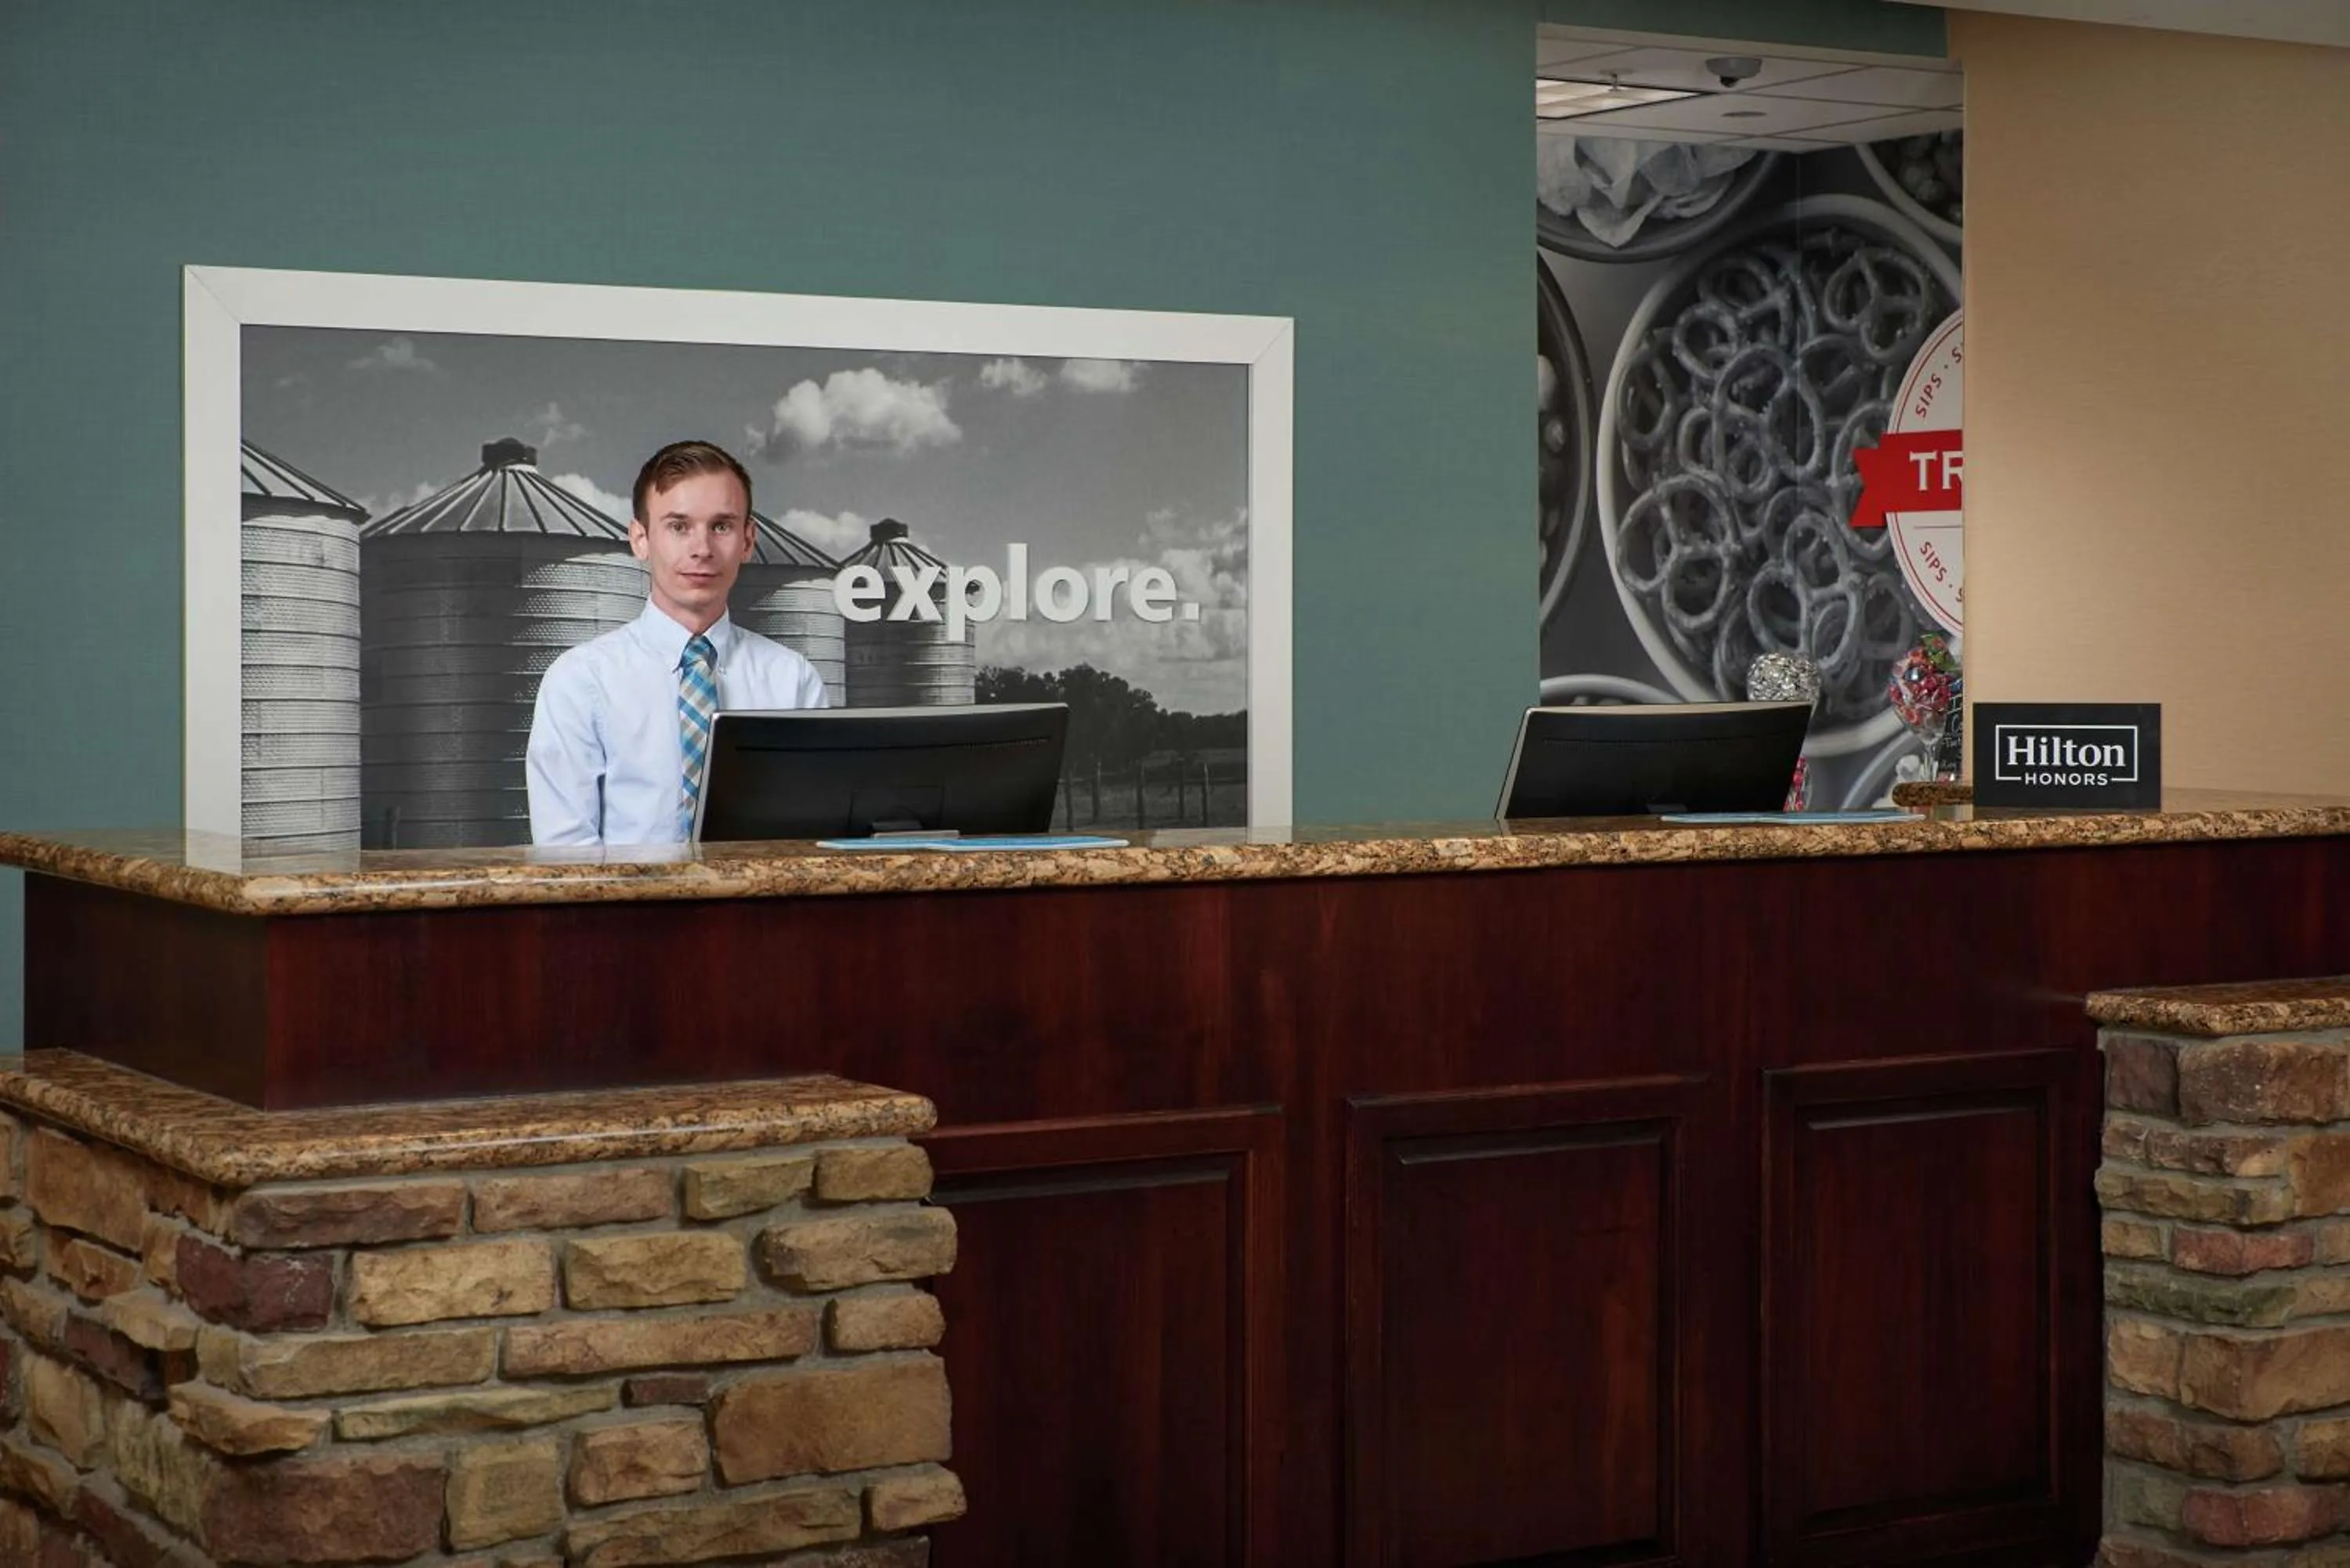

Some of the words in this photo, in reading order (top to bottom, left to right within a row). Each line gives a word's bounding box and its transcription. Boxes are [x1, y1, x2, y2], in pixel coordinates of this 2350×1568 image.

[1915, 374, 1942, 418] SIPS
[1920, 540, 1947, 583] SIPS
[833, 543, 1199, 641] explore.
[2007, 735, 2126, 767] Hilton
[2024, 772, 2109, 786] HONORS
